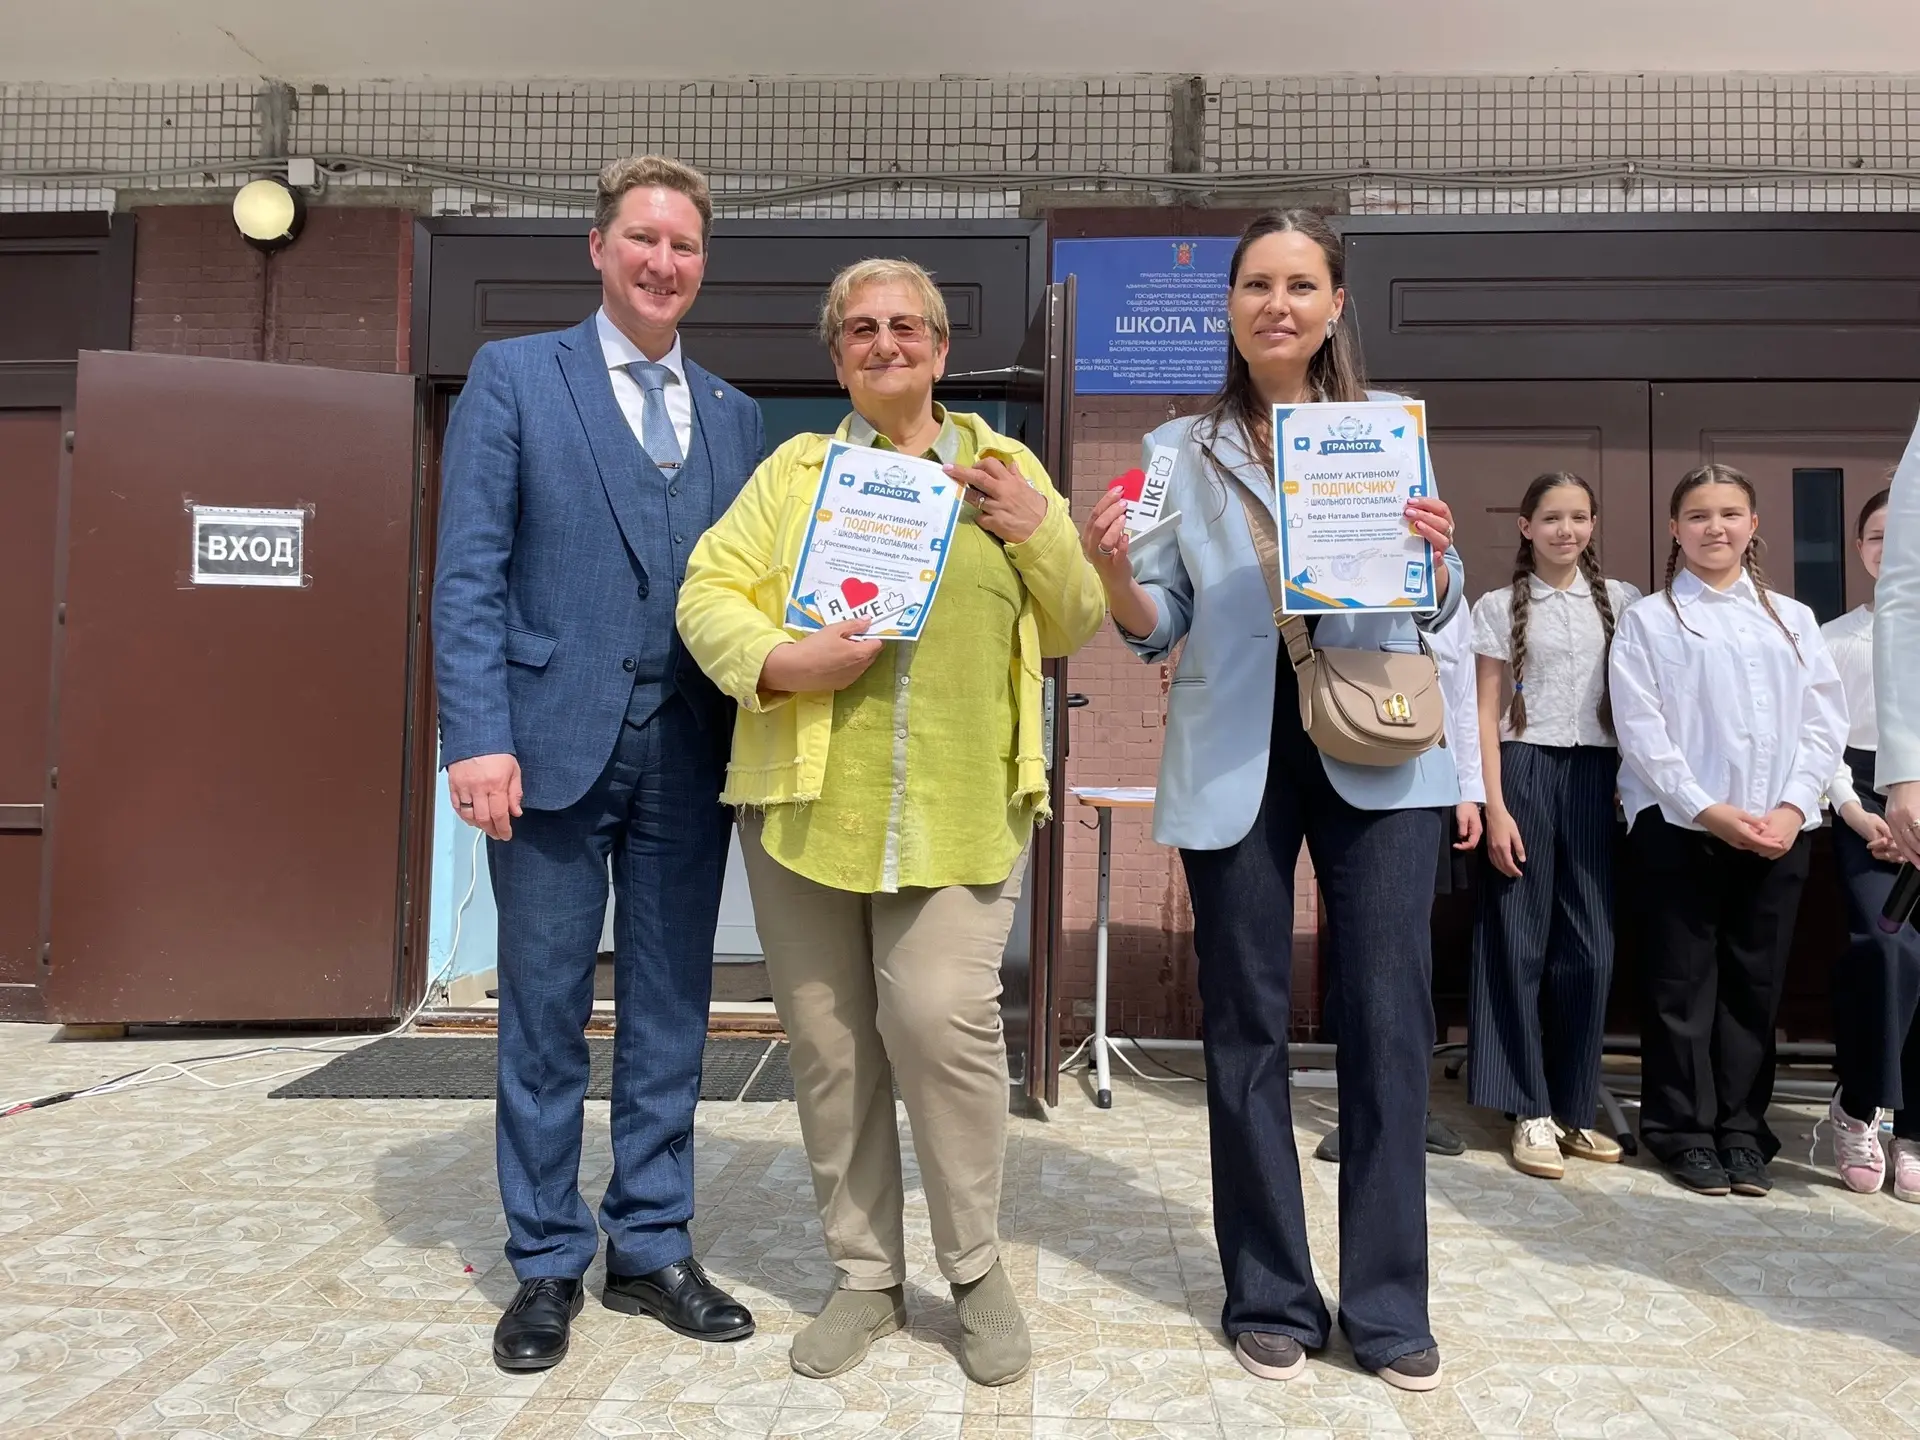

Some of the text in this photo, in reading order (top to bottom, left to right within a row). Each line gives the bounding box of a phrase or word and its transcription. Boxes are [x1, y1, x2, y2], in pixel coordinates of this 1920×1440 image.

[1116, 316, 1226, 333] ШКОЛА №
[1326, 442, 1376, 451] ГРАМОТА
[1345, 470, 1400, 480] АКТИВНОМУ
[868, 484, 914, 500] ГРАМОТА
[1312, 480, 1396, 497] ПОДПИСЧИКУ
[1140, 478, 1166, 518] LIKE
[1310, 496, 1398, 506] ШКОЛЬНОГО ГОСПАБЛИКА
[840, 506, 928, 528] САМОМУ АКТИВНОМУ
[842, 516, 922, 540] ПОДПИСЧИКУ
[838, 530, 918, 550] ШКОЛЬНОГО ГОСПАБЛИКА
[208, 536, 294, 568] ВХОД
[872, 548, 900, 559] Зинаиде
[828, 598, 842, 616] Я
